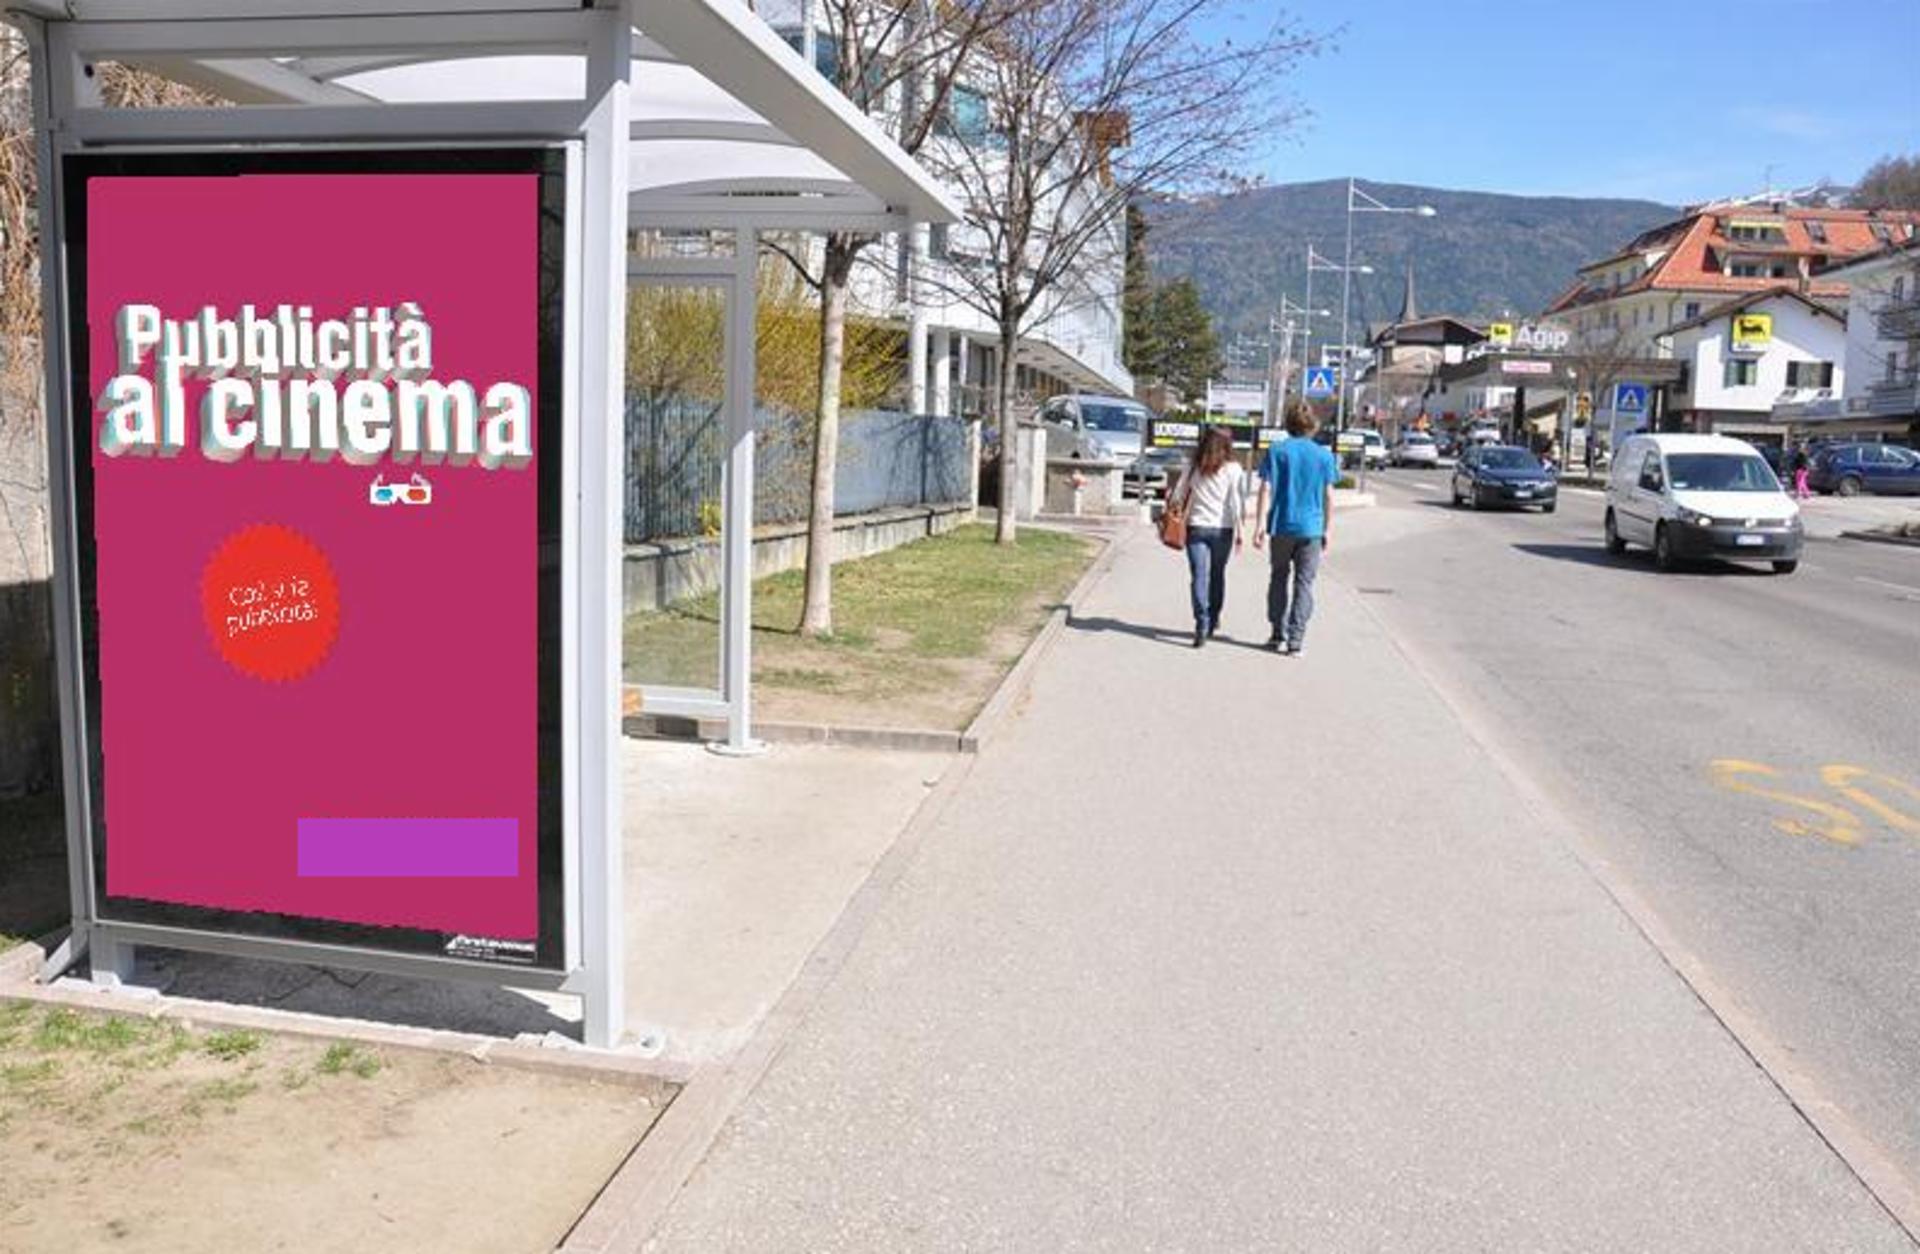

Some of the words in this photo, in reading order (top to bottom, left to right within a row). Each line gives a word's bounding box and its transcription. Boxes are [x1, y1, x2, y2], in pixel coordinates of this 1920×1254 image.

[118, 302, 432, 380] Pubblicità
[1515, 325, 1570, 348] Agip
[100, 367, 186, 457] al
[202, 374, 533, 469] cinema
